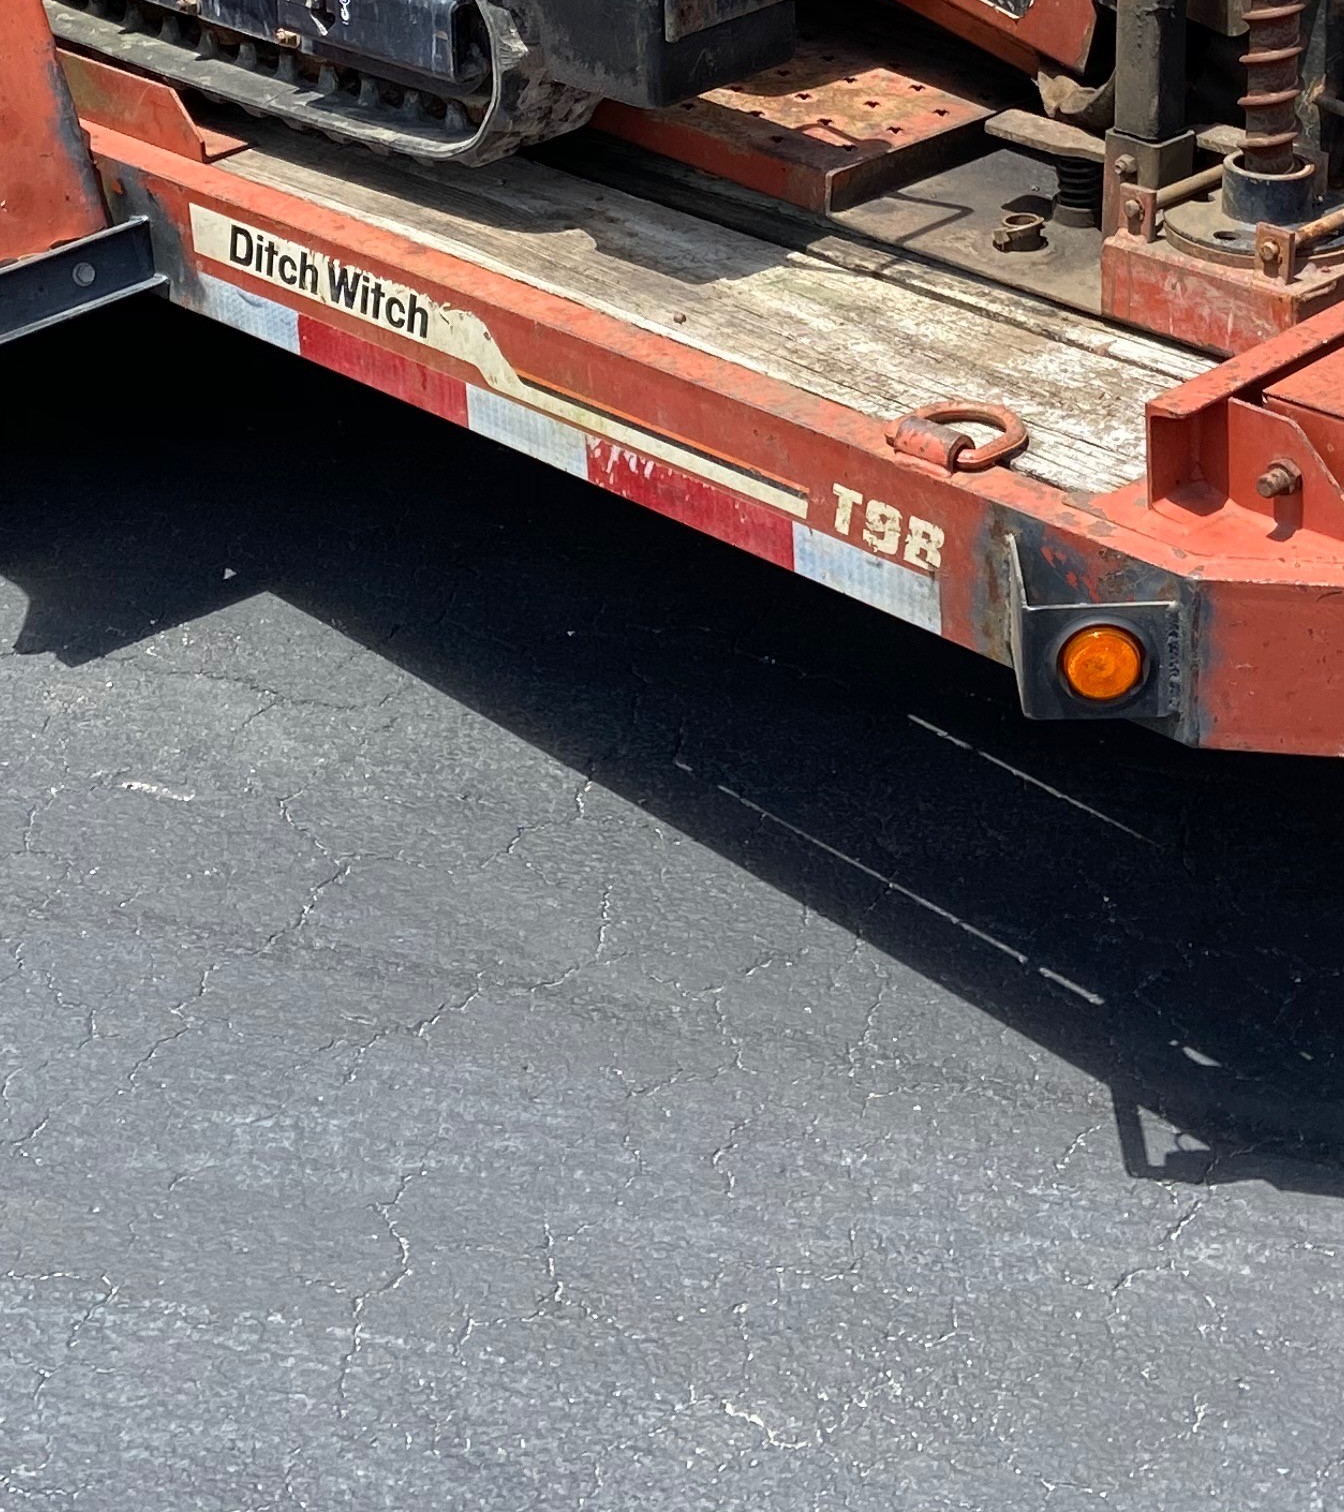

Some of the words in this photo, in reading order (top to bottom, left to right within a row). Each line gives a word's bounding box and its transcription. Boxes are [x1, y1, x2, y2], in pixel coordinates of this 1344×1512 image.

[229, 224, 320, 296] Ditch
[327, 258, 430, 339] Witch
[832, 482, 946, 571] T9B
